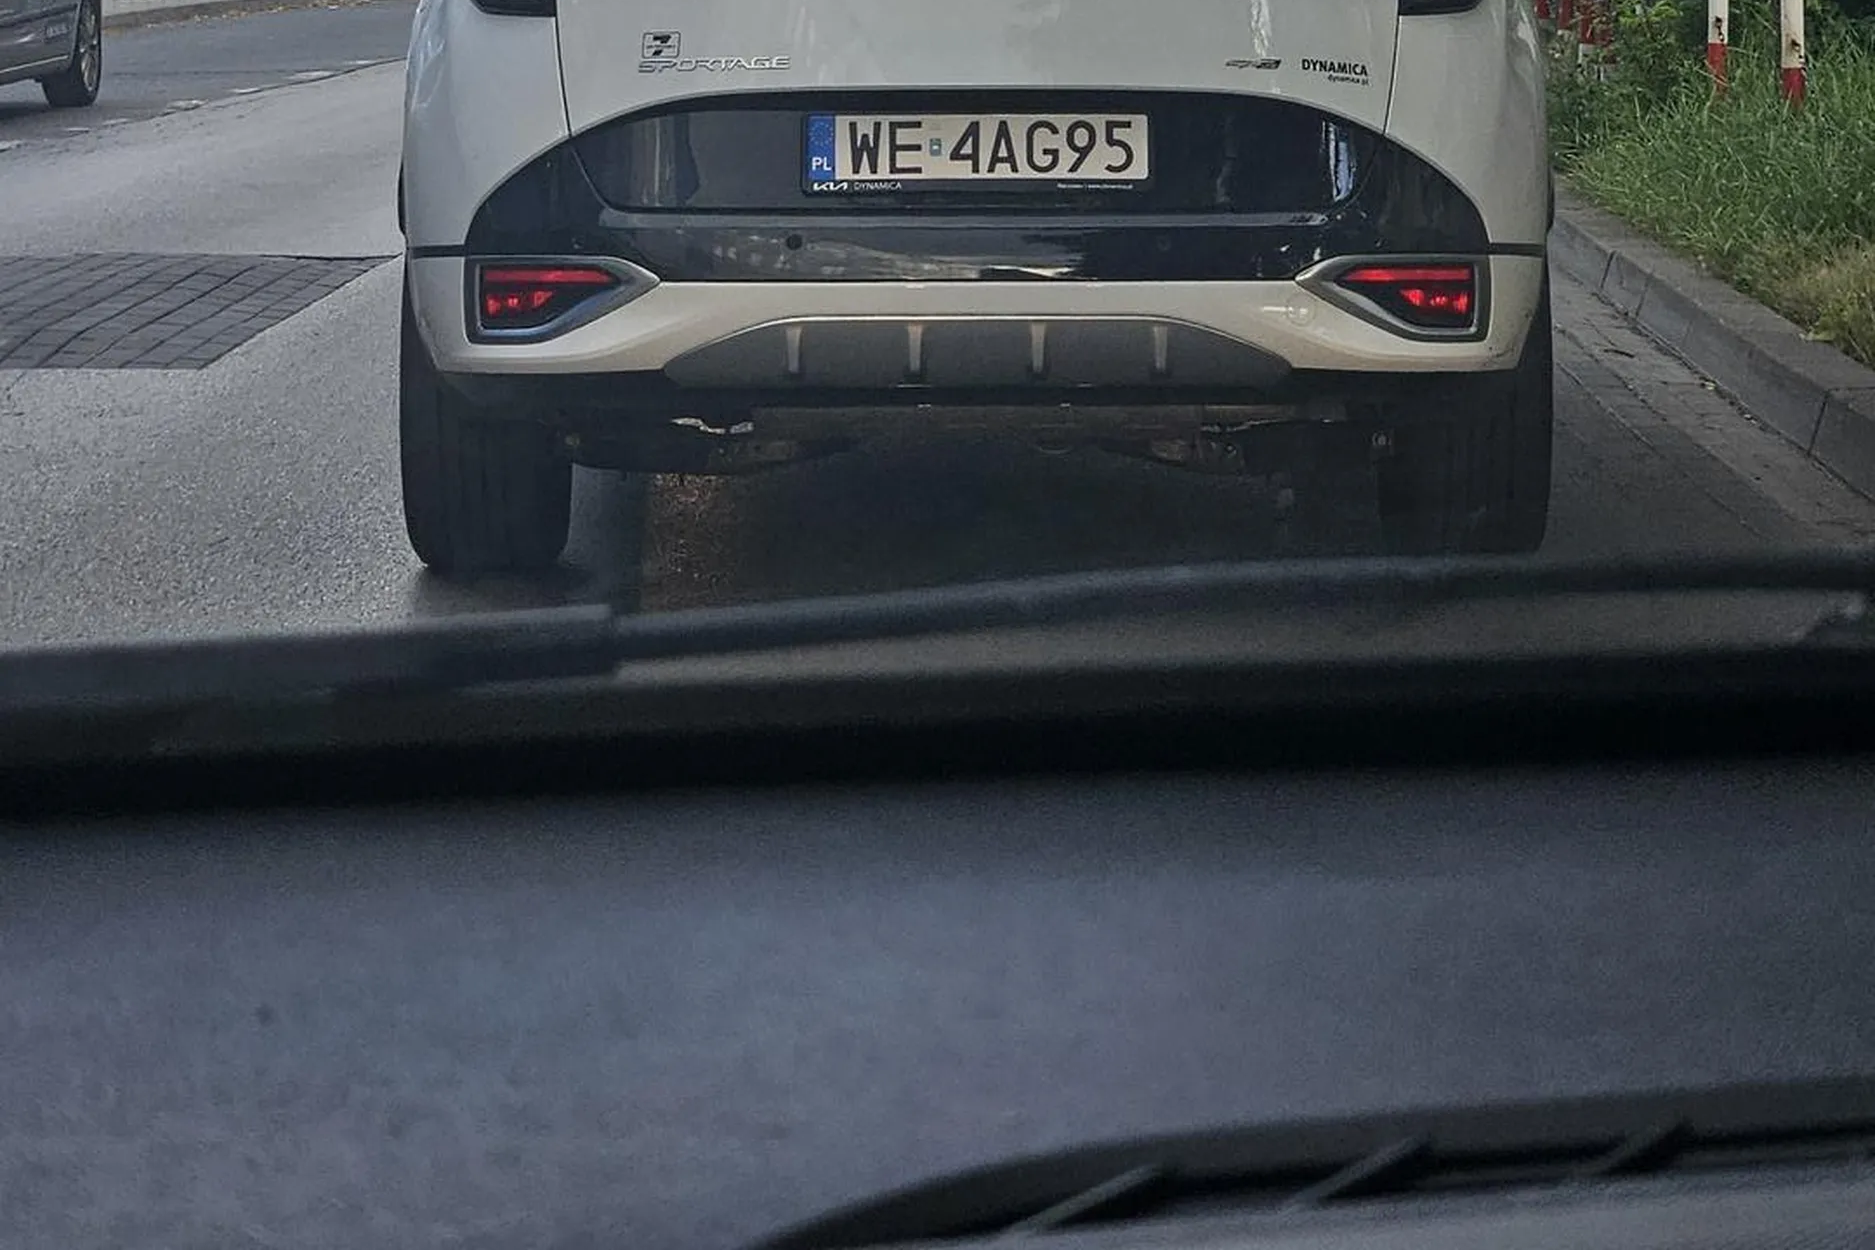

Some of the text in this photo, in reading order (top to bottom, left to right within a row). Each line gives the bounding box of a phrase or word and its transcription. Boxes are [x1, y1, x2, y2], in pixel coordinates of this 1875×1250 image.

[638, 55, 790, 73] SPORTAGE
[1301, 58, 1368, 77] DYNAMICA
[848, 120, 1134, 174] WE 4AG95
[812, 156, 832, 171] PL
[813, 181, 902, 191] KIA DYNAMICA
